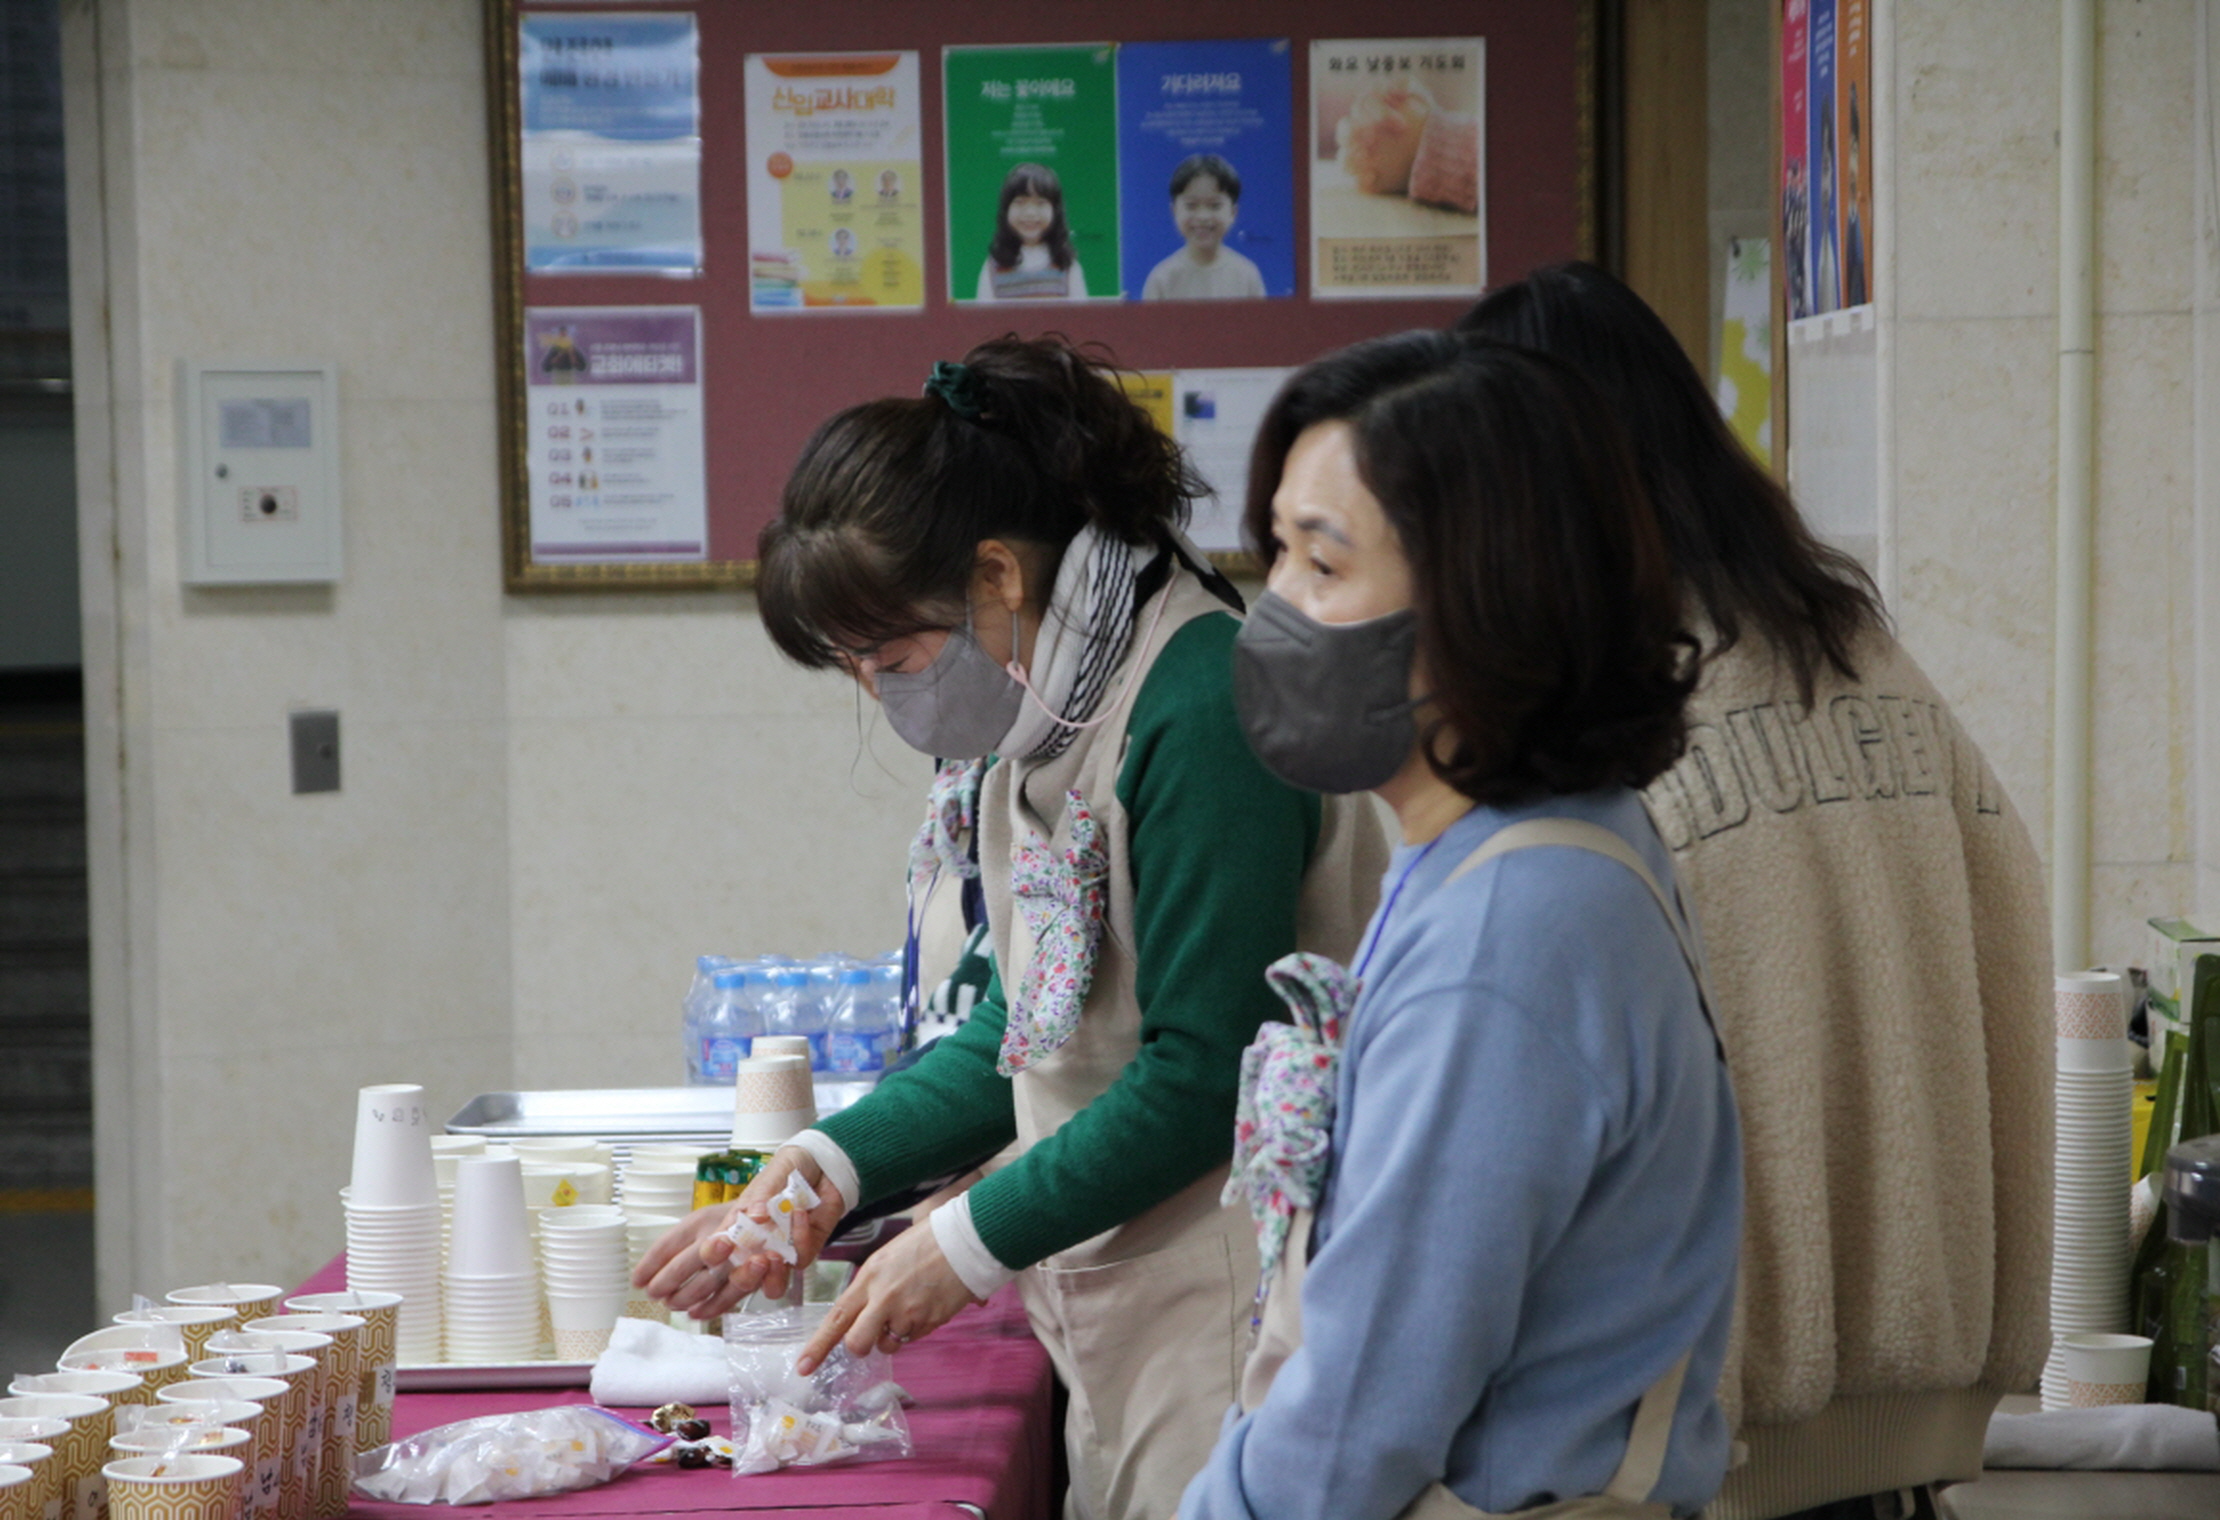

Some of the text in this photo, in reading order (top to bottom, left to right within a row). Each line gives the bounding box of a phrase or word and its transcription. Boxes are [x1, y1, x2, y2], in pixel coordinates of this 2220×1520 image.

[1419, 54, 1466, 70] 기도회
[547, 402, 570, 416] Q1
[549, 471, 573, 485] Q4
